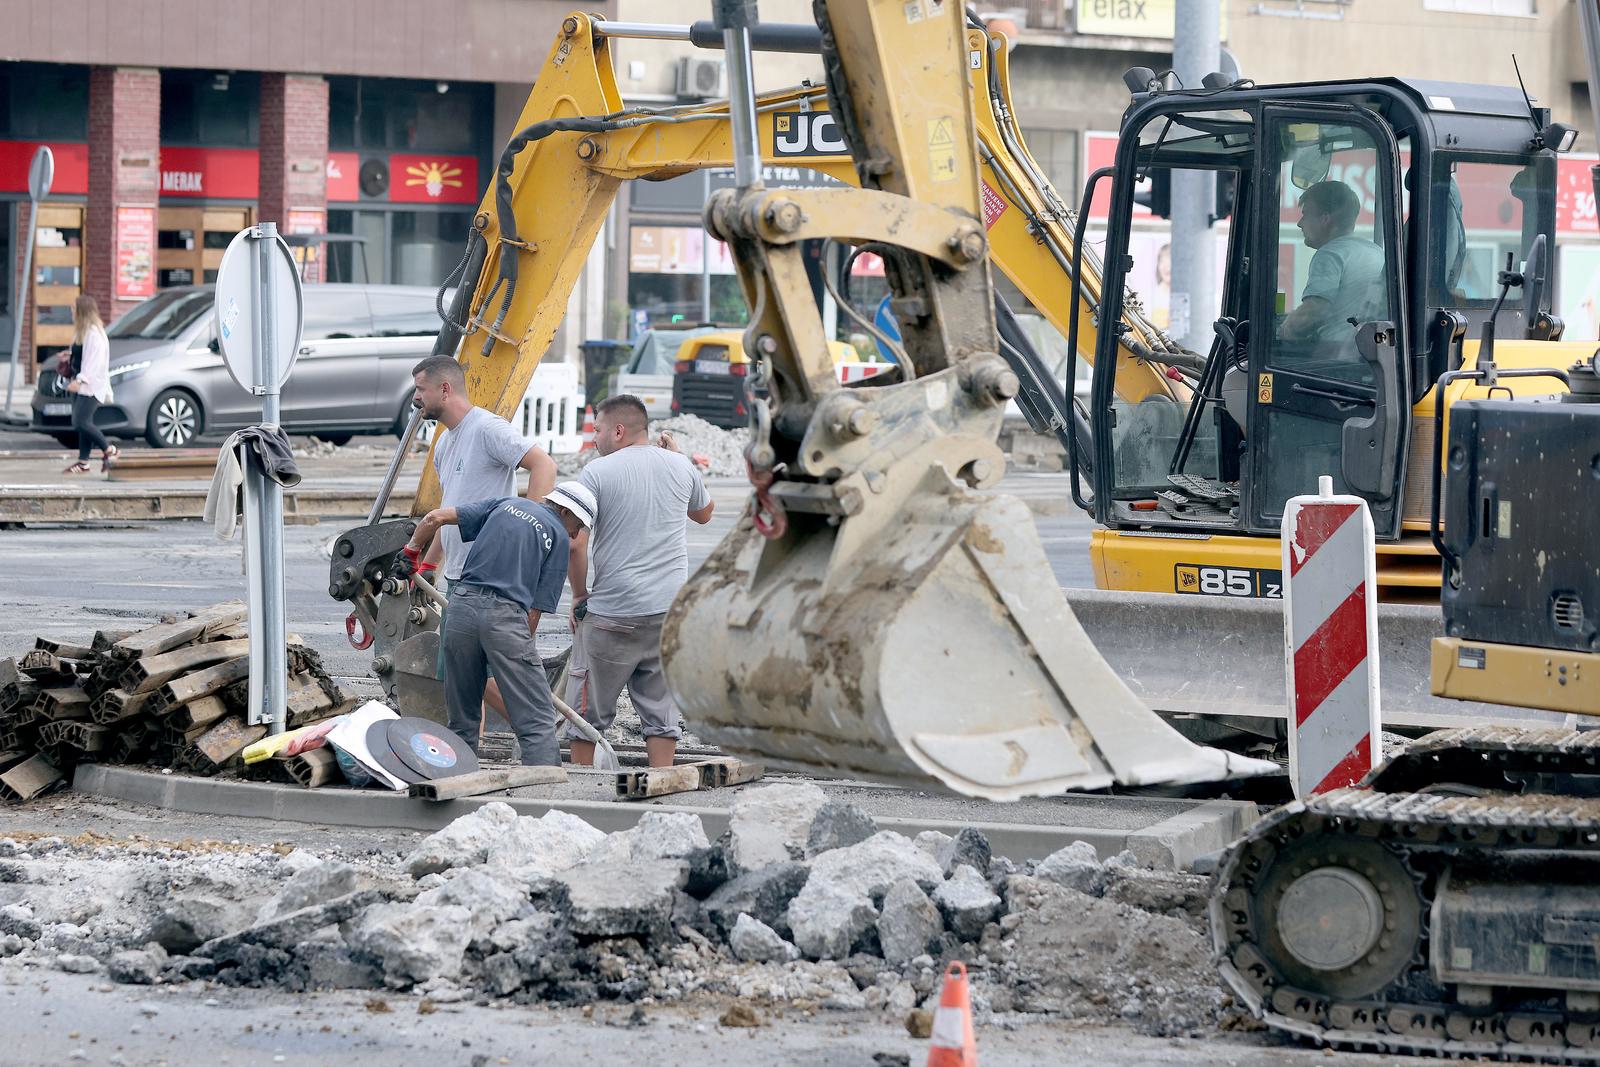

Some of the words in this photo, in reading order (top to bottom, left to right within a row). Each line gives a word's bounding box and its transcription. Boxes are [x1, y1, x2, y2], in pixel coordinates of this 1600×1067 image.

[1082, 0, 1147, 20] relax
[162, 171, 203, 192] MERAK
[774, 168, 800, 181] TEA
[504, 504, 543, 532] INOUTIC
[1200, 568, 1252, 596] 85
[1266, 583, 1284, 598] Z
